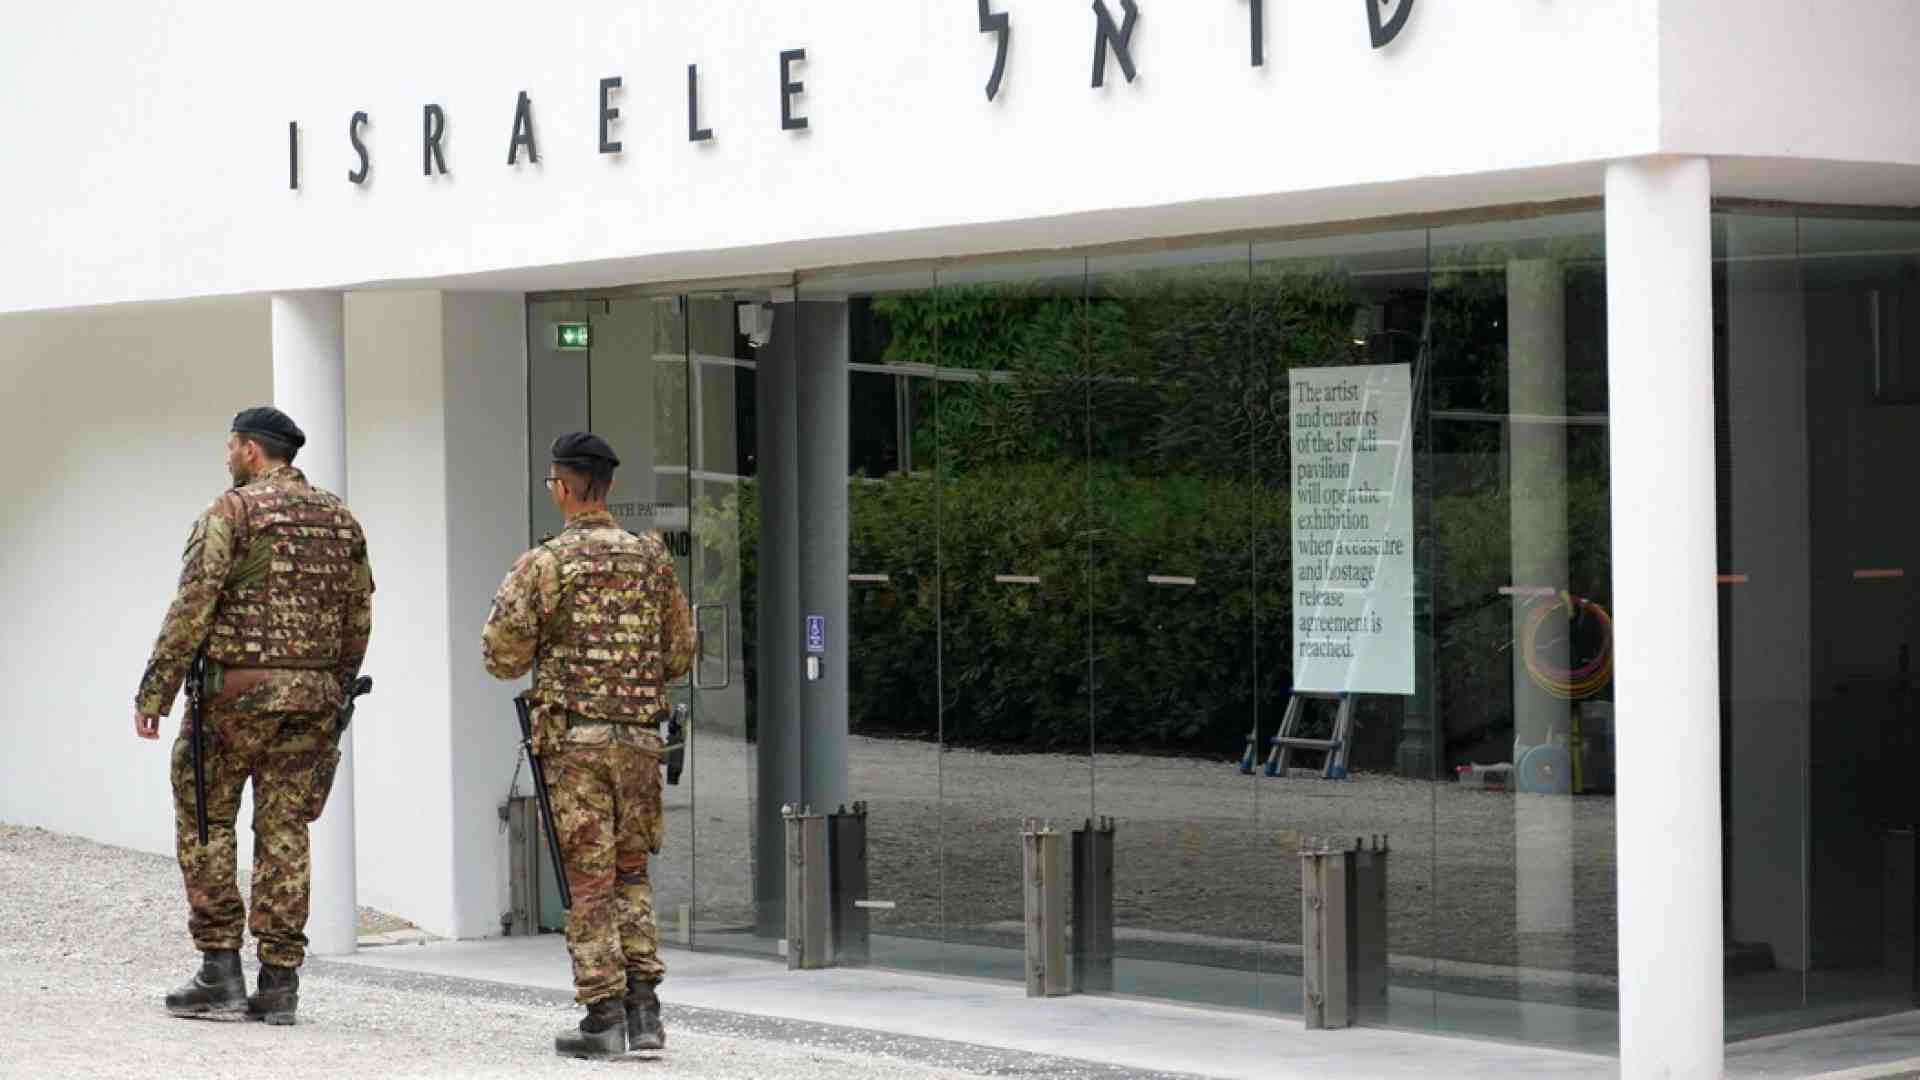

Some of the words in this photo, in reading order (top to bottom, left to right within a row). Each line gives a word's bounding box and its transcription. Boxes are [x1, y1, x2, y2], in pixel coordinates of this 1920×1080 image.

[289, 48, 808, 189] ISRAELE
[1296, 381, 1322, 402] The
[1325, 380, 1359, 401] artist
[1296, 406, 1320, 427] and
[1323, 410, 1377, 427] curators
[1296, 432, 1312, 453] of
[1313, 432, 1332, 452] the
[1297, 456, 1349, 484] pavilion
[1297, 482, 1321, 504] will
[1323, 488, 1357, 511] open
[1359, 481, 1380, 503] the
[1298, 508, 1369, 529] exhibition
[1298, 534, 1334, 556] when
[1298, 560, 1322, 580] and
[1325, 560, 1376, 588] hostage
[1299, 584, 1344, 607] release
[1299, 615, 1369, 638] agreement
[1372, 610, 1383, 633] is
[1299, 634, 1354, 658] reached.
